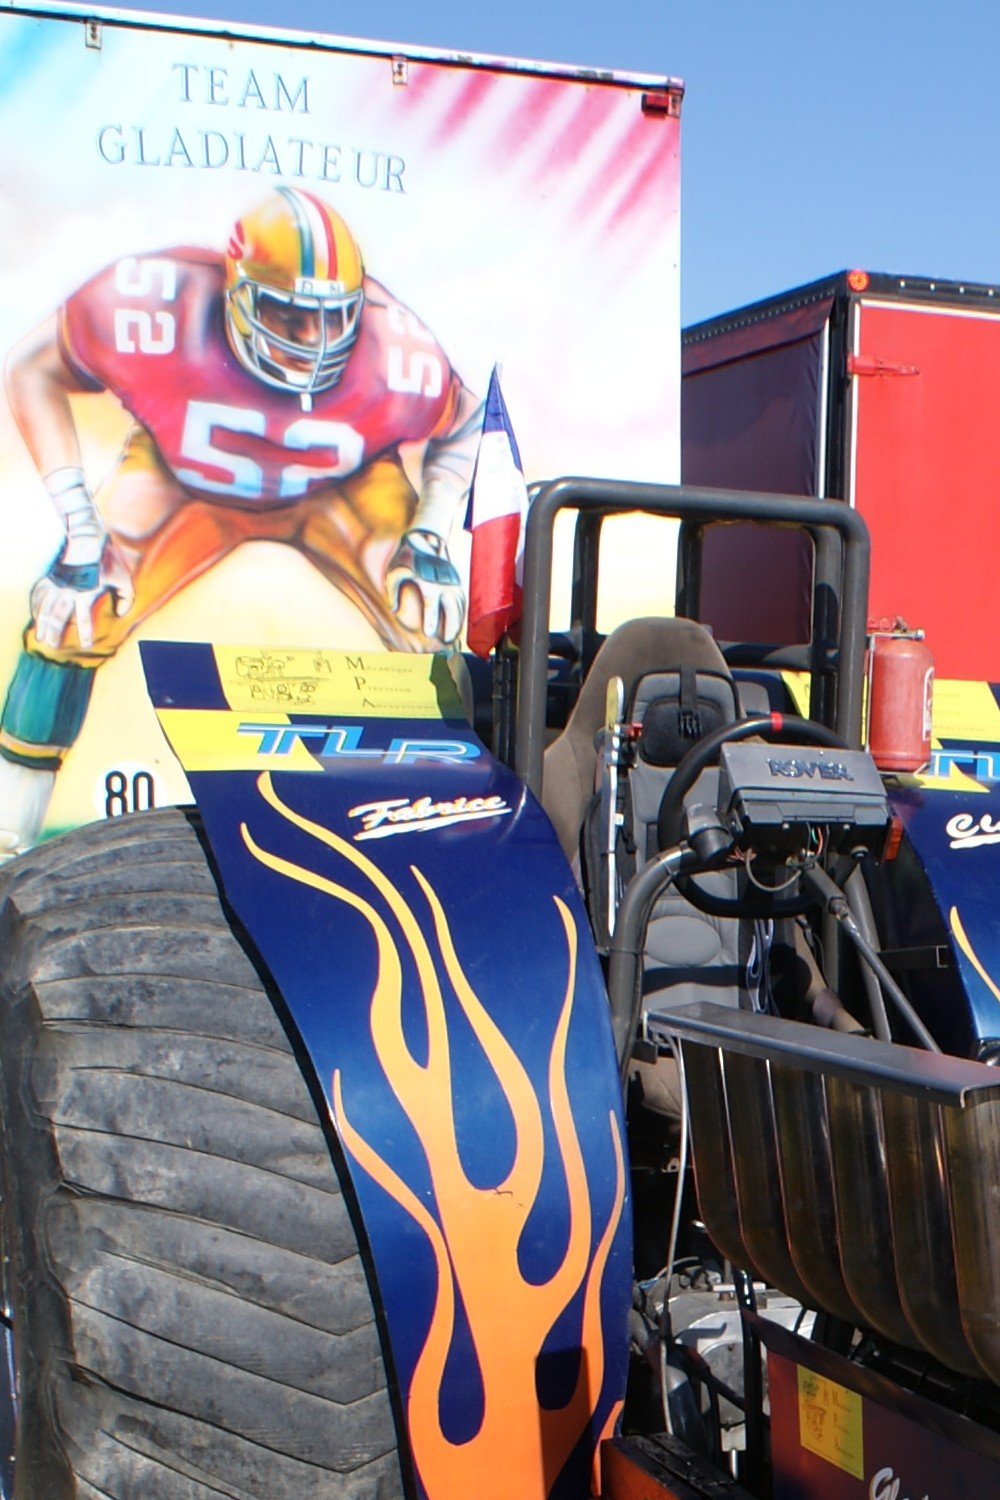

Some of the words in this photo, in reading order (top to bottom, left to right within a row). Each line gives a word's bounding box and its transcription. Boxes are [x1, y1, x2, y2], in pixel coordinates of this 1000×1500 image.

[171, 62, 311, 114] TEAM
[97, 122, 407, 194] GLADIATEUR
[176, 400, 366, 499] 52
[237, 722, 482, 766] TLR
[766, 758, 855, 781] ROVER
[105, 770, 155, 819] 80
[348, 796, 510, 837] Fabrice
